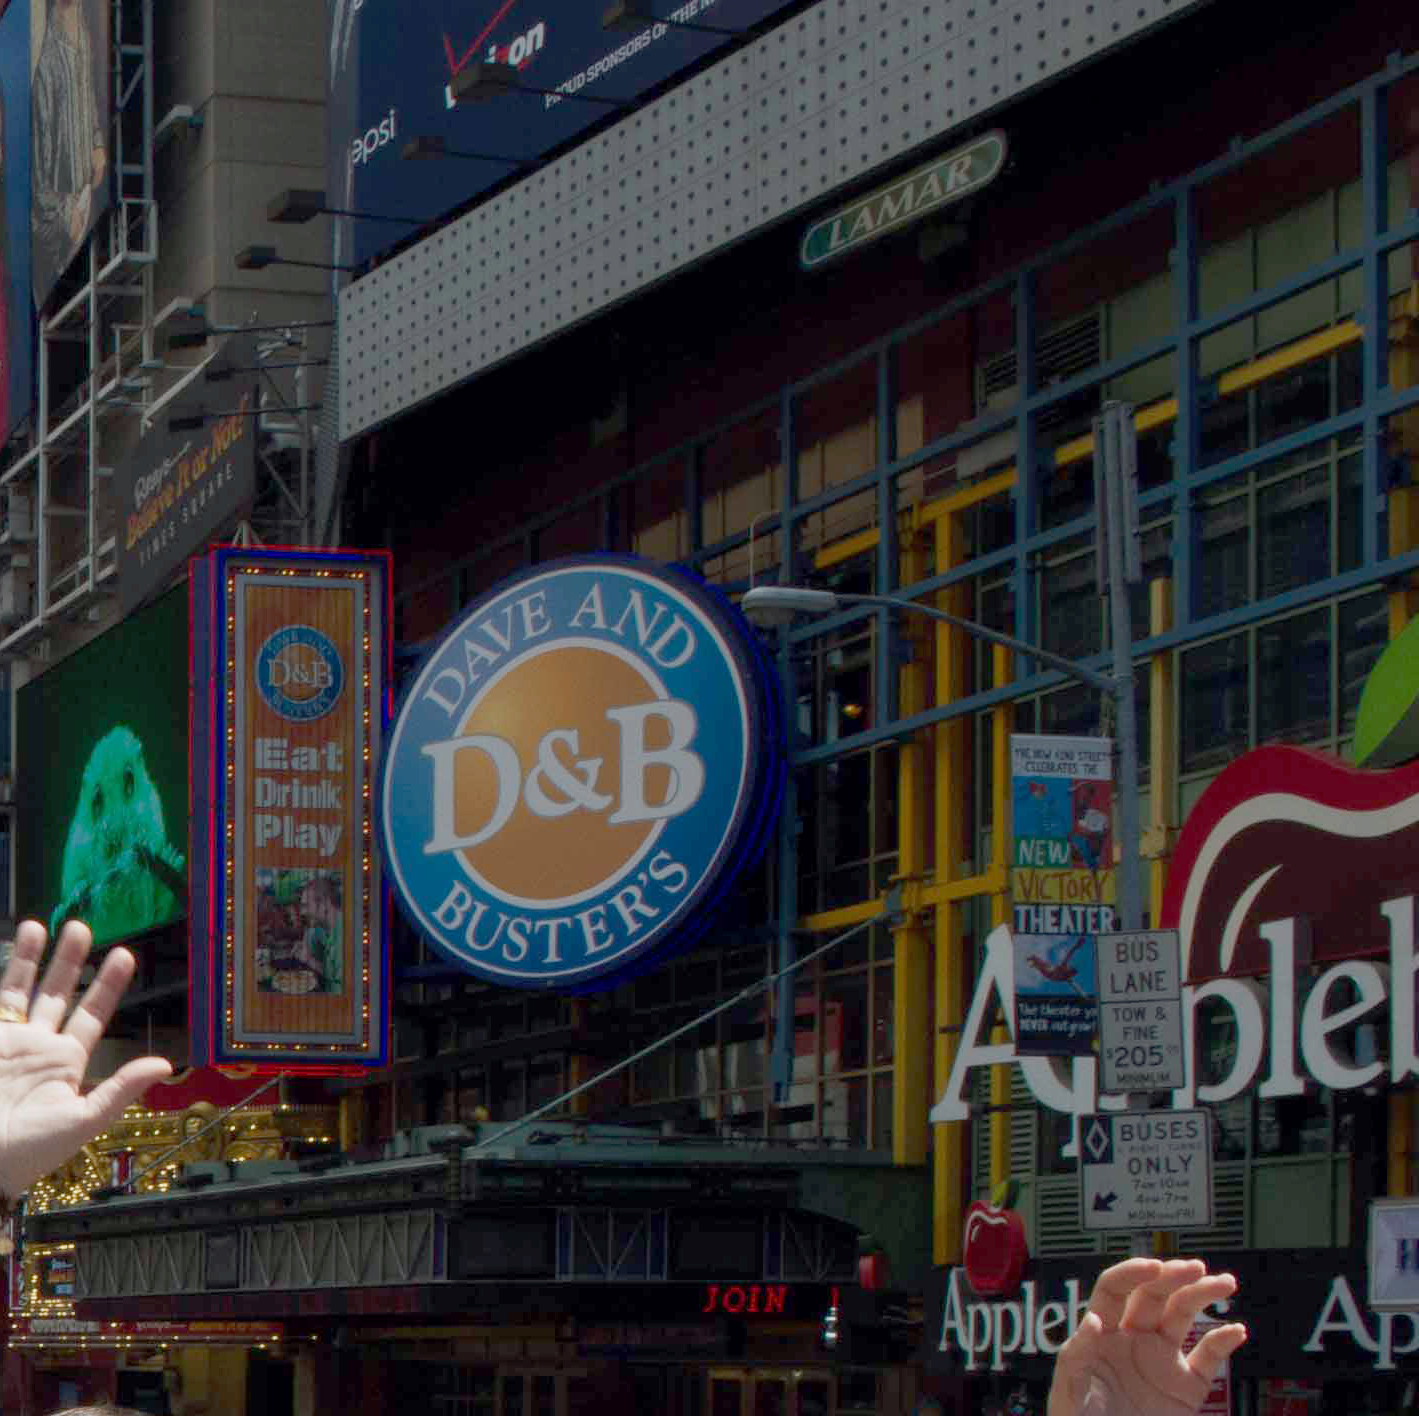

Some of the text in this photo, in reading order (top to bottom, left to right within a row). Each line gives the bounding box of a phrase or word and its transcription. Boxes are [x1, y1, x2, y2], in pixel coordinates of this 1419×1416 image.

[586, 29, 652, 83] SPONSORS
[828, 154, 975, 249] LAMAR
[179, 462, 233, 525] SQUARE
[422, 582, 698, 718] DAVE AND
[254, 736, 345, 772] Eat
[254, 776, 344, 809] Drink
[420, 697, 705, 856] D&B
[254, 813, 344, 857] Play
[1019, 837, 1072, 867] NEW
[1016, 870, 1109, 903] VICTORY
[432, 849, 691, 965] BUSTER'S
[1015, 903, 1116, 935] THEATER
[1116, 940, 1160, 964] BUS
[1110, 969, 1169, 995] LANE
[1113, 1005, 1167, 1023] TOW &
[1122, 1025, 1160, 1042] FINE
[1120, 1119, 1199, 1141] BUSES
[1128, 1154, 1194, 1175] ONLY
[701, 1284, 790, 1313] JOIN
